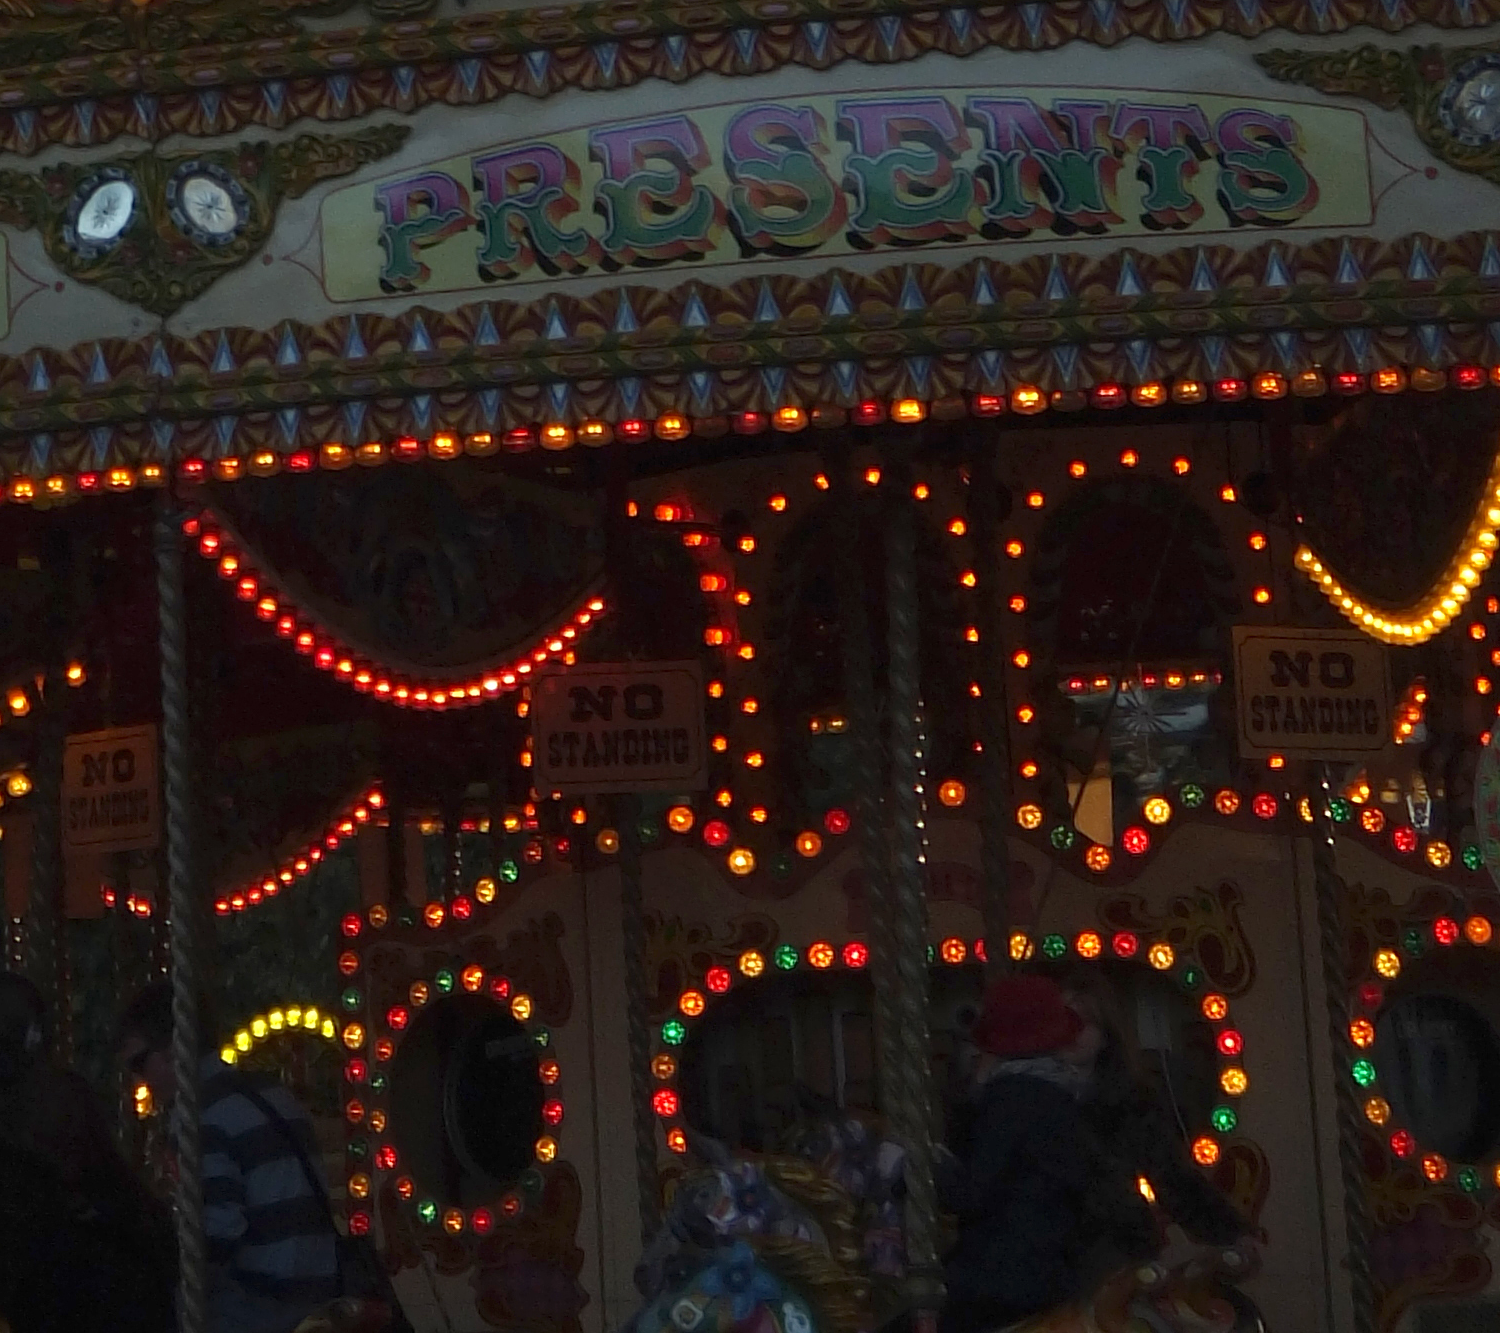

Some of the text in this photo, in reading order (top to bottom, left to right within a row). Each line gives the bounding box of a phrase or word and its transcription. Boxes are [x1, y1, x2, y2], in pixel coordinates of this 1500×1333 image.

[375, 95, 1321, 292] PRESENTS
[1269, 650, 1355, 688] NO
[568, 683, 663, 722] NO
[1251, 695, 1379, 734] STANDING
[82, 748, 135, 787] NO
[549, 728, 690, 768] STANDING
[68, 789, 150, 831] STANDING
